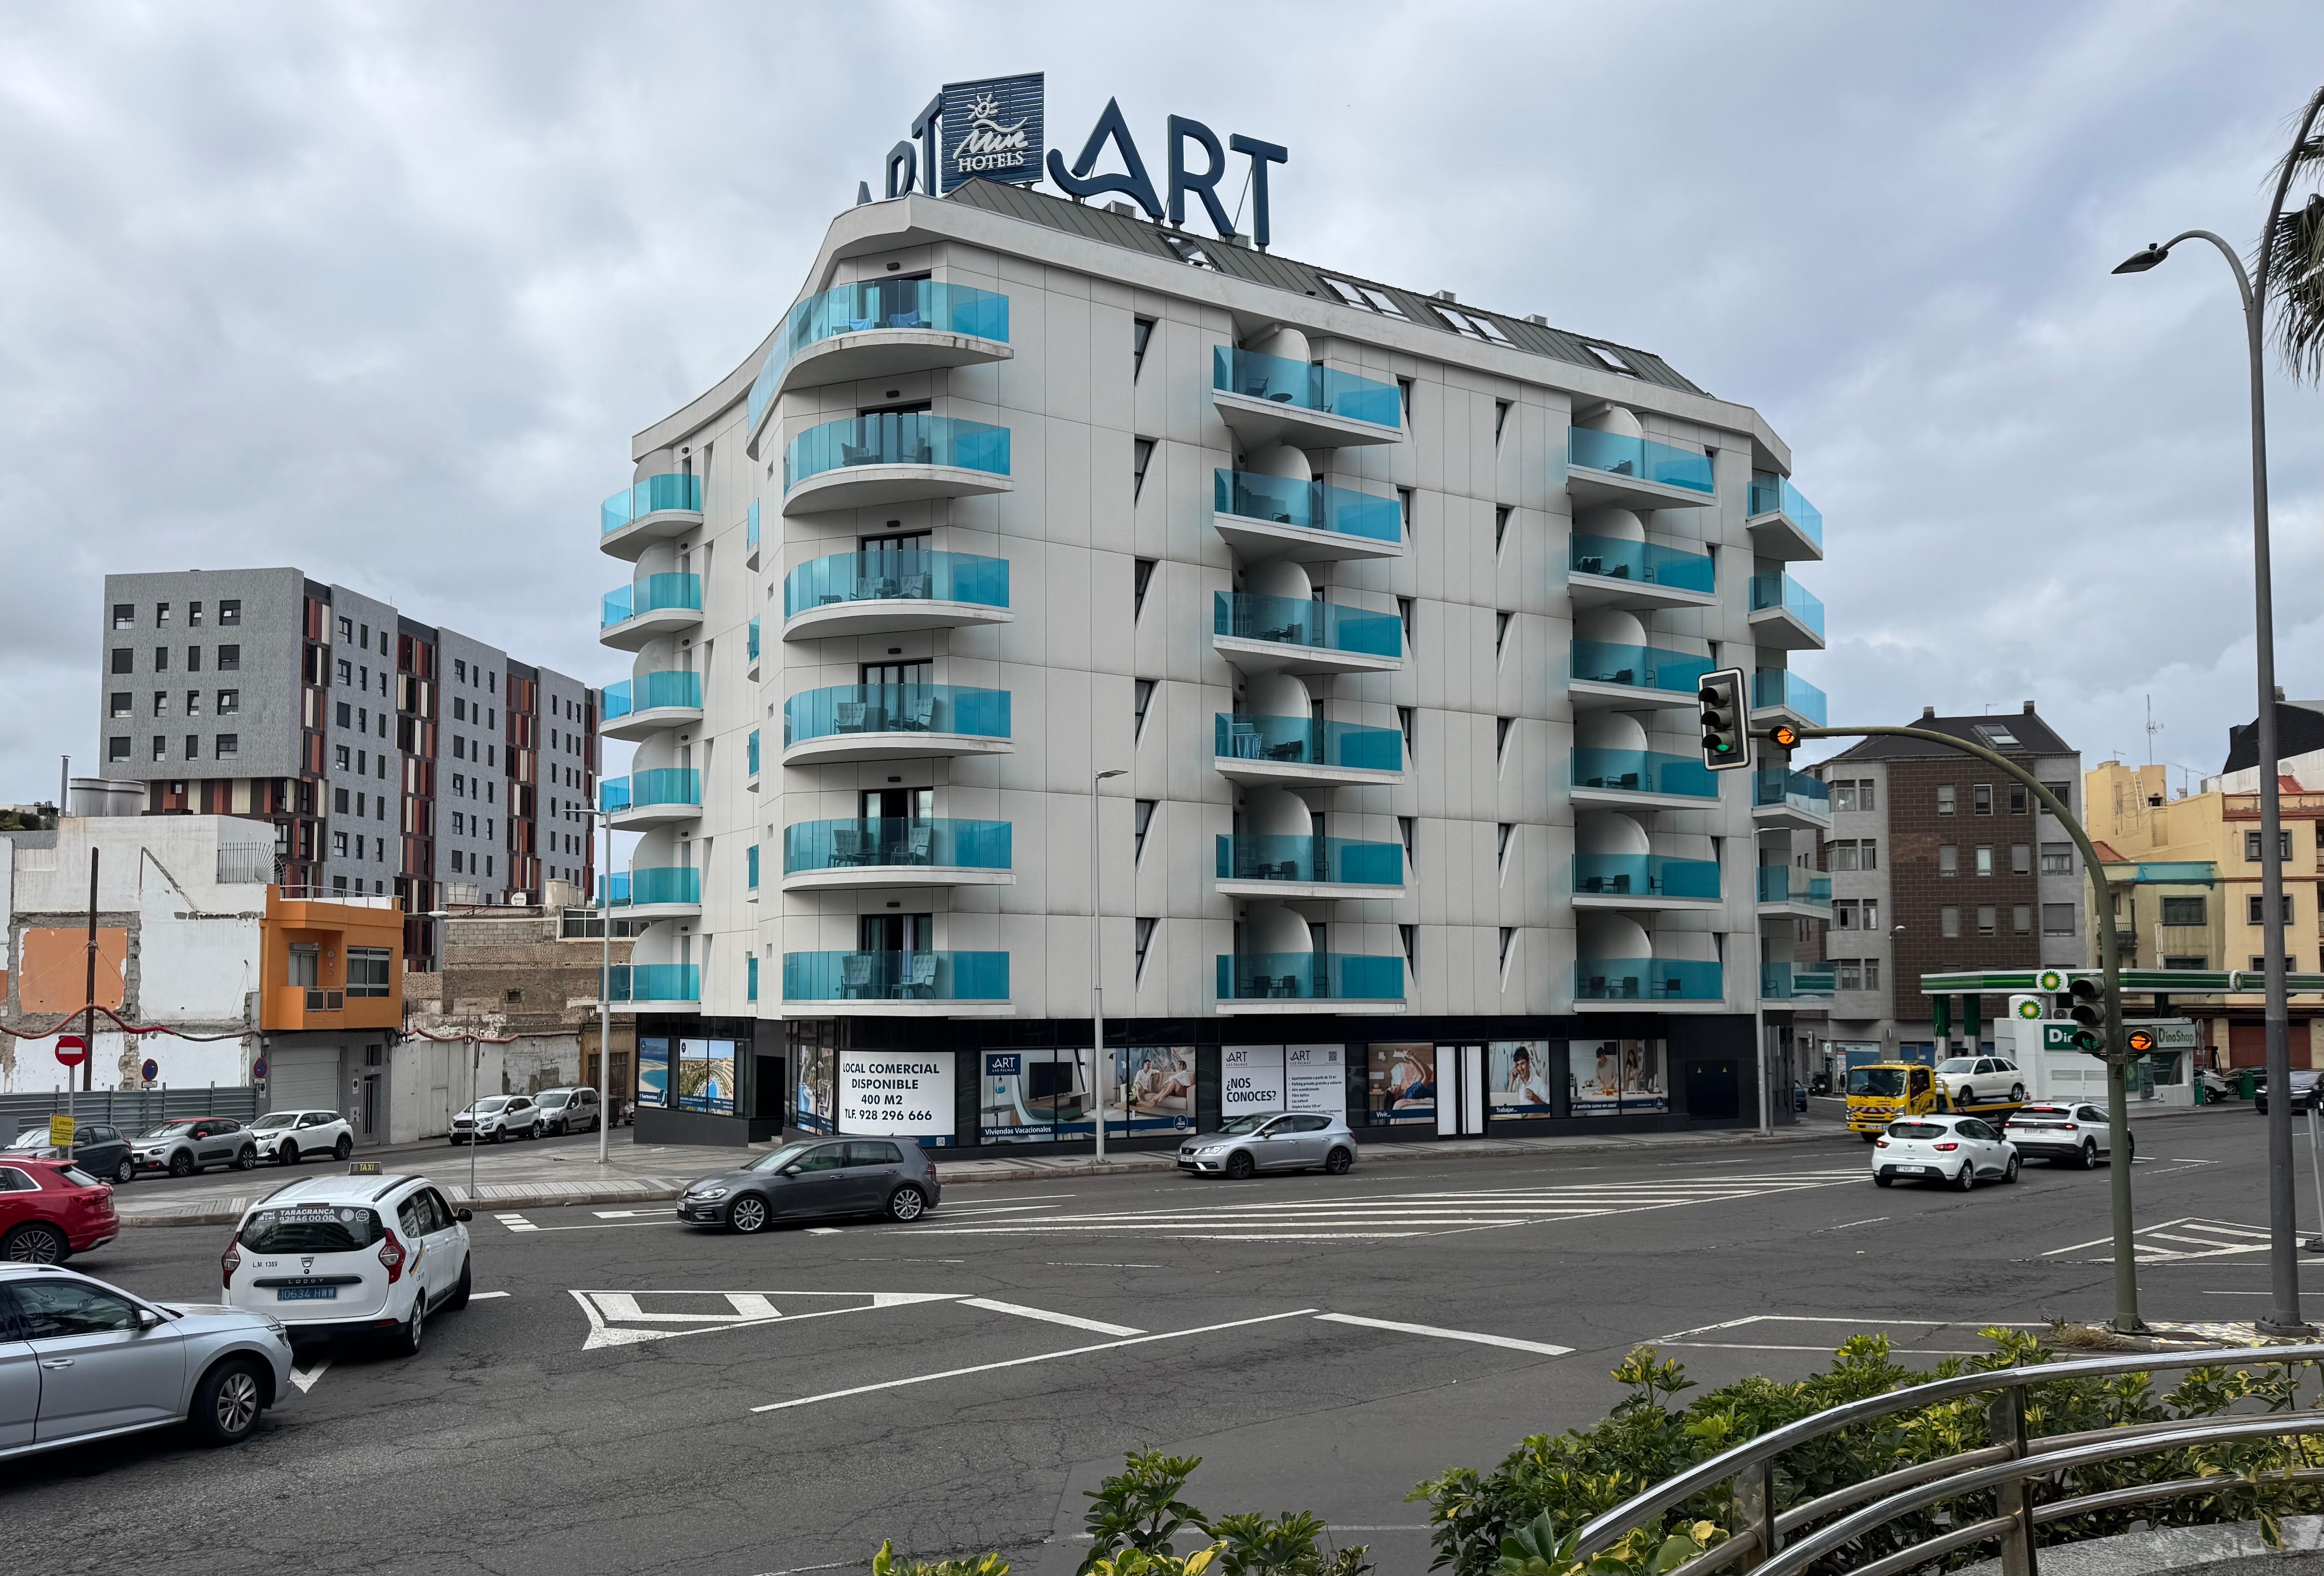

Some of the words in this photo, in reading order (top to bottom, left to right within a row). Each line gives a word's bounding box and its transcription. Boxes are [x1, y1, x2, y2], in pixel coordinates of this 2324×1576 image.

[958, 150, 1024, 172] HOTELS
[1046, 95, 1288, 245] ART
[2158, 1027, 2194, 1043] DinoShop
[1226, 1052, 1248, 1062] ART
[1290, 1050, 1310, 1060] ART
[843, 1062, 865, 1073] LOCAL
[869, 1063, 940, 1074] COMERCIAL
[992, 1057, 1015, 1068] ART
[852, 1079, 918, 1089] DISPONIBLE
[1226, 1078, 1251, 1091] ¿NOS
[861, 1094, 880, 1105] 400
[884, 1095, 903, 1105] M2
[1227, 1091, 1276, 1102] CONOCES?
[845, 1108, 856, 1119] TLF.
[859, 1110, 878, 1120] 928
[882, 1110, 904, 1120] 296
[908, 1110, 932, 1120] 666
[1015, 1126, 1051, 1134] Vacacionales
[284, 1289, 310, 1298] 0634
